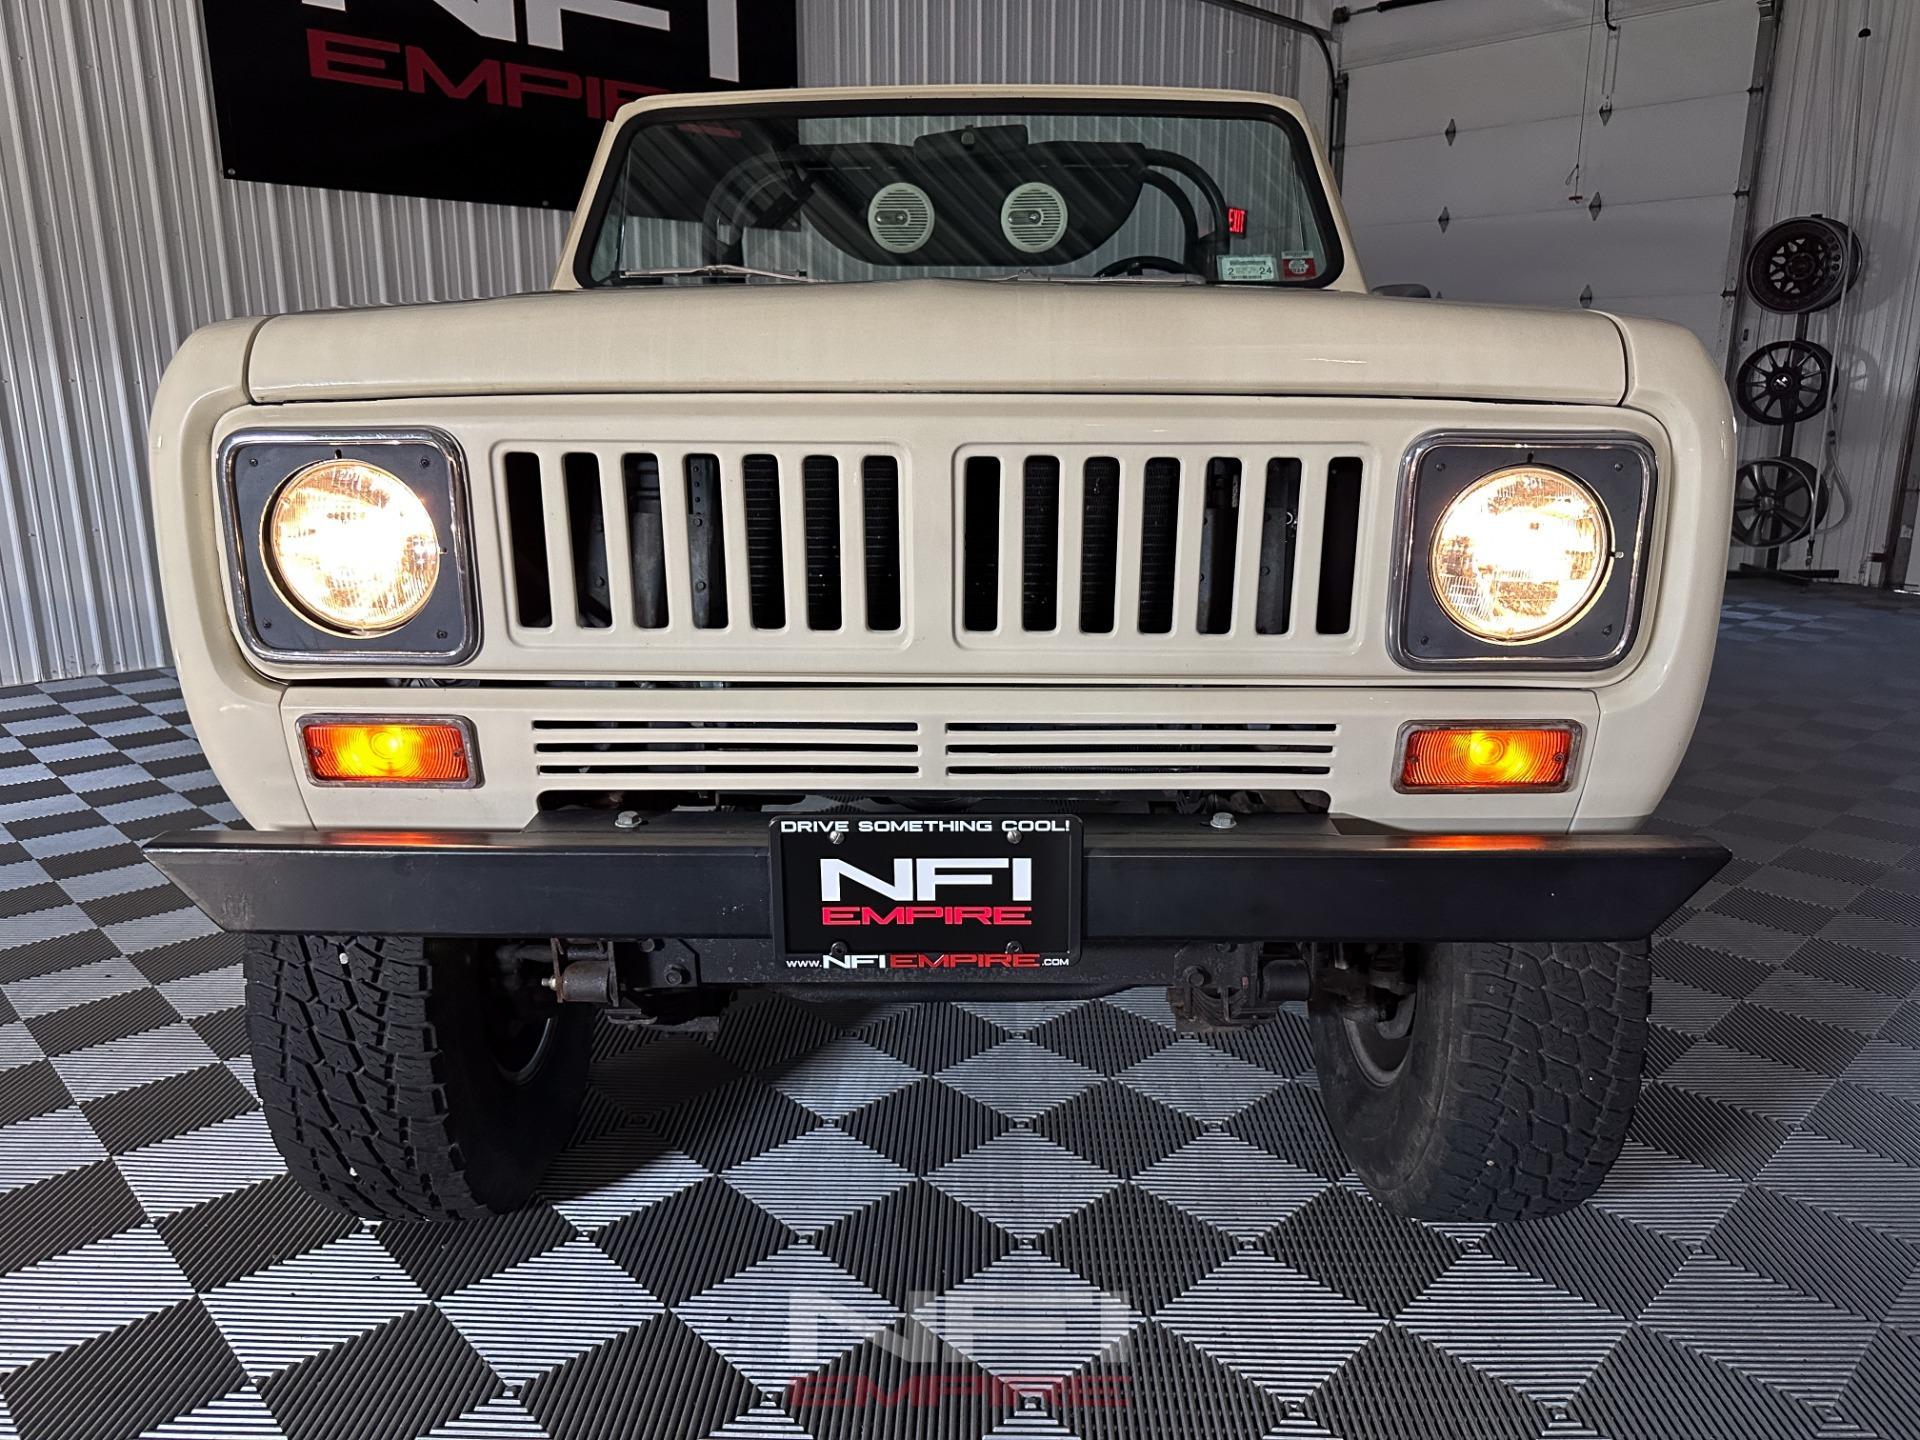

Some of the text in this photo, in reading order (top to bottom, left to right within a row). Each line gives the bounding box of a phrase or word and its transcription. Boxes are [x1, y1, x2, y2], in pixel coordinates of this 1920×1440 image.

[1228, 207, 1246, 233] EXIT
[780, 820, 1071, 833] DRIVE SOMETHING COOL!
[820, 858, 1032, 901] NFI
[822, 906, 1032, 925] EMPIRE
